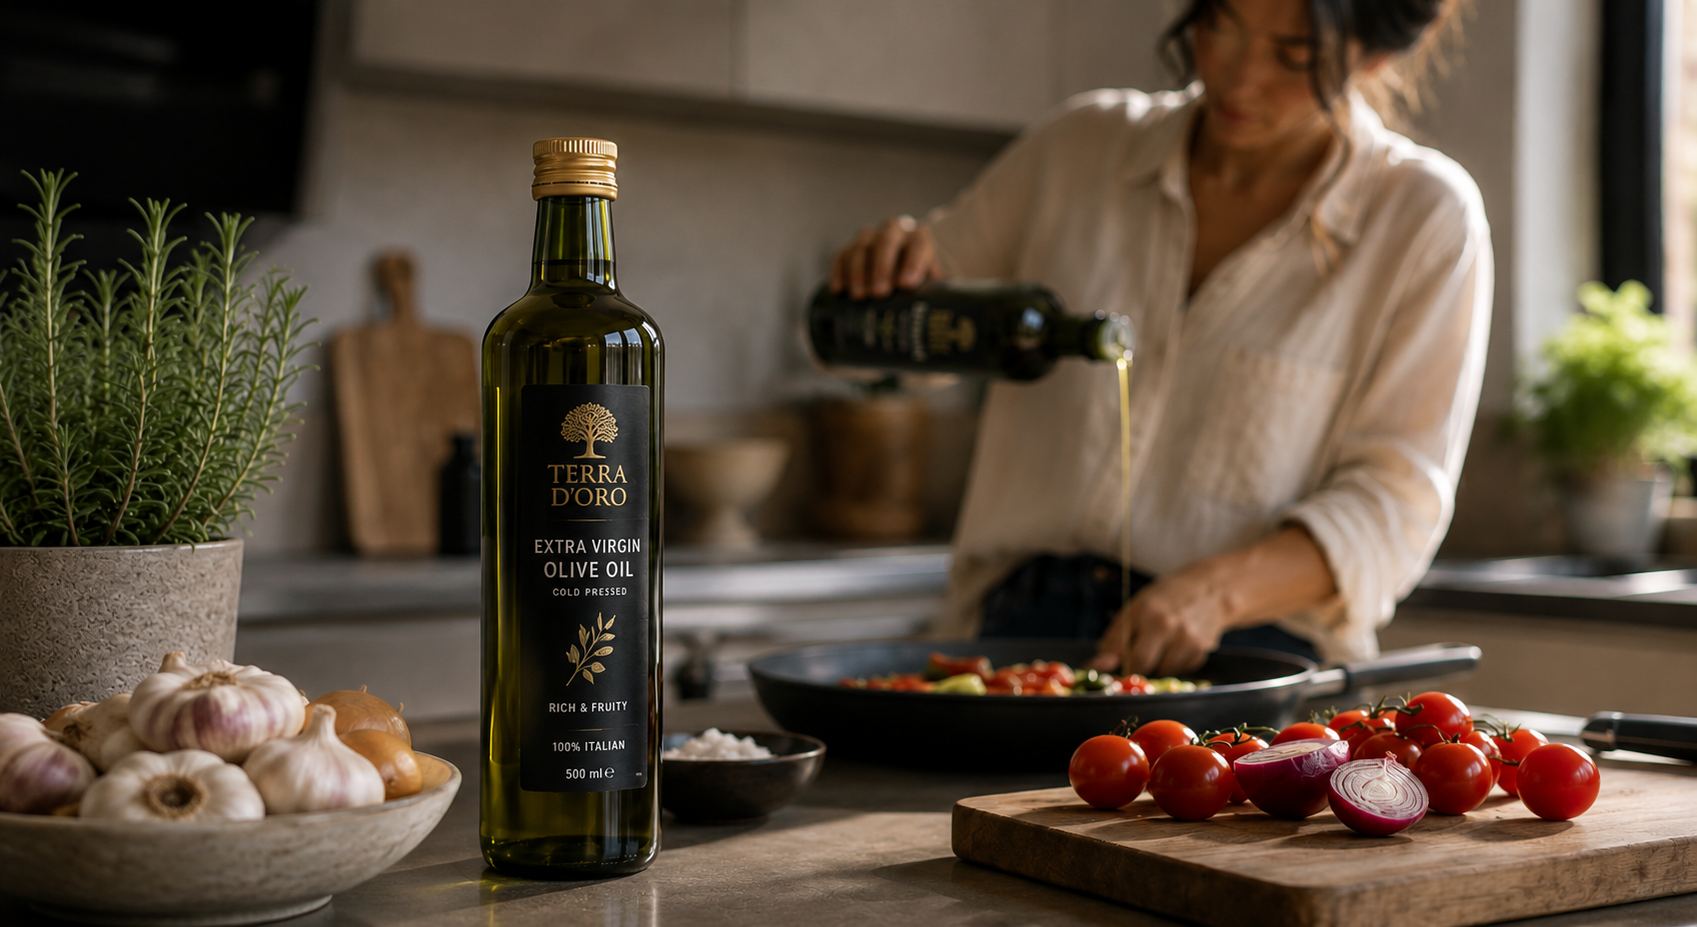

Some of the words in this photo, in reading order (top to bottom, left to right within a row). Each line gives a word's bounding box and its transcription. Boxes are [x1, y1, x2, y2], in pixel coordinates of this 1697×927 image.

[547, 464, 628, 484] TERRA
[550, 487, 627, 507] D'ORO
[534, 539, 587, 554] EXTRA
[591, 538, 641, 554] VIRGIN
[543, 561, 599, 578] OLIVE
[606, 561, 634, 578] OIL
[552, 587, 581, 597] COLD
[584, 587, 628, 597] PRESSED
[549, 702, 576, 713] RICH
[580, 702, 588, 713] &
[591, 700, 628, 712] FRUITY
[552, 741, 581, 752] 100%
[584, 740, 626, 752] ITALIAN
[565, 768, 586, 779] 500
